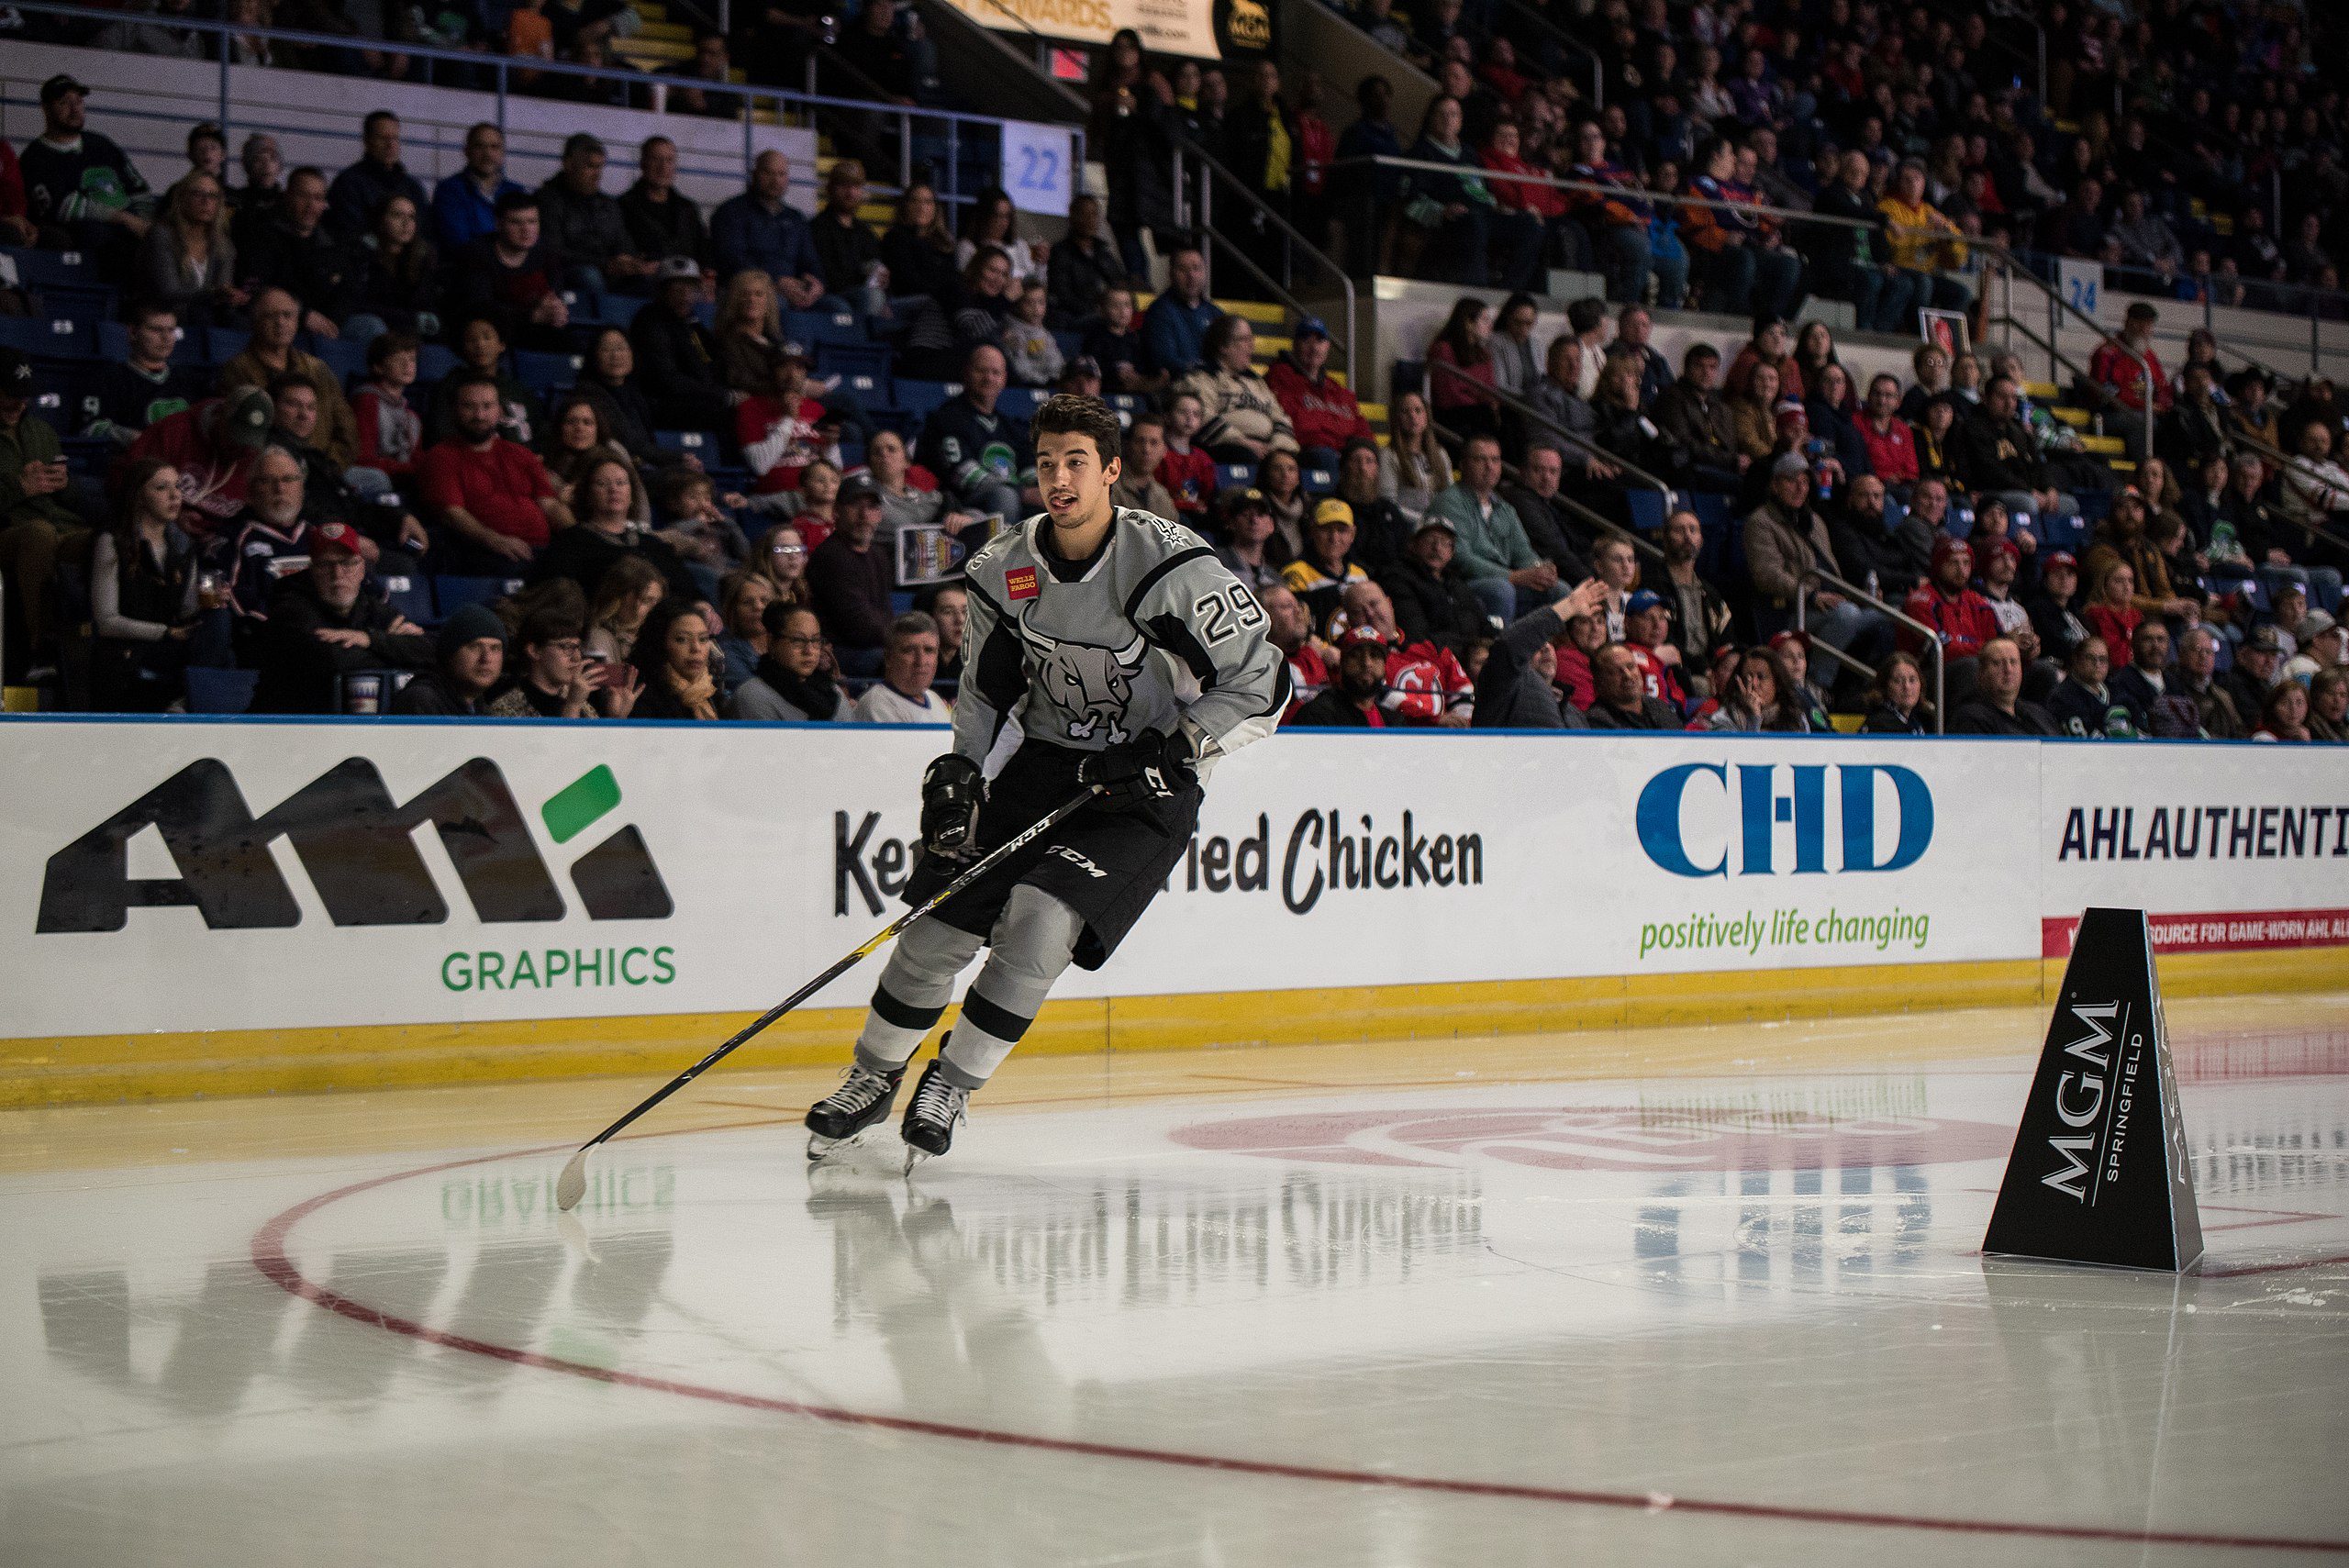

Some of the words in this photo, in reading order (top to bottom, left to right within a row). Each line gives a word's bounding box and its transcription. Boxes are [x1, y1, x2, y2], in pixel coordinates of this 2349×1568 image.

[1019, 145, 1059, 191] 22
[2069, 278, 2097, 313] 24
[1008, 574, 1035, 584] WELLS
[1010, 582, 1036, 592] FARGO
[1194, 581, 1266, 649] 29
[1635, 759, 1935, 882] CHD
[2058, 806, 2349, 862] AHLAUTHENTI
[1160, 811, 1271, 893] ied
[1283, 808, 1485, 916] Chicken
[1639, 909, 1766, 960] positively
[1770, 907, 1810, 946] life
[1815, 906, 1931, 951] changing
[2151, 923, 2199, 945] SOURCE
[2200, 921, 2227, 943] FOR
[2228, 919, 2306, 942] GAME-WORN
[2307, 917, 2330, 940] AHL
[440, 945, 677, 993] GRAPHICS
[2042, 999, 2120, 1204] MGM
[2107, 1033, 2143, 1183] SPRINGFIELD
